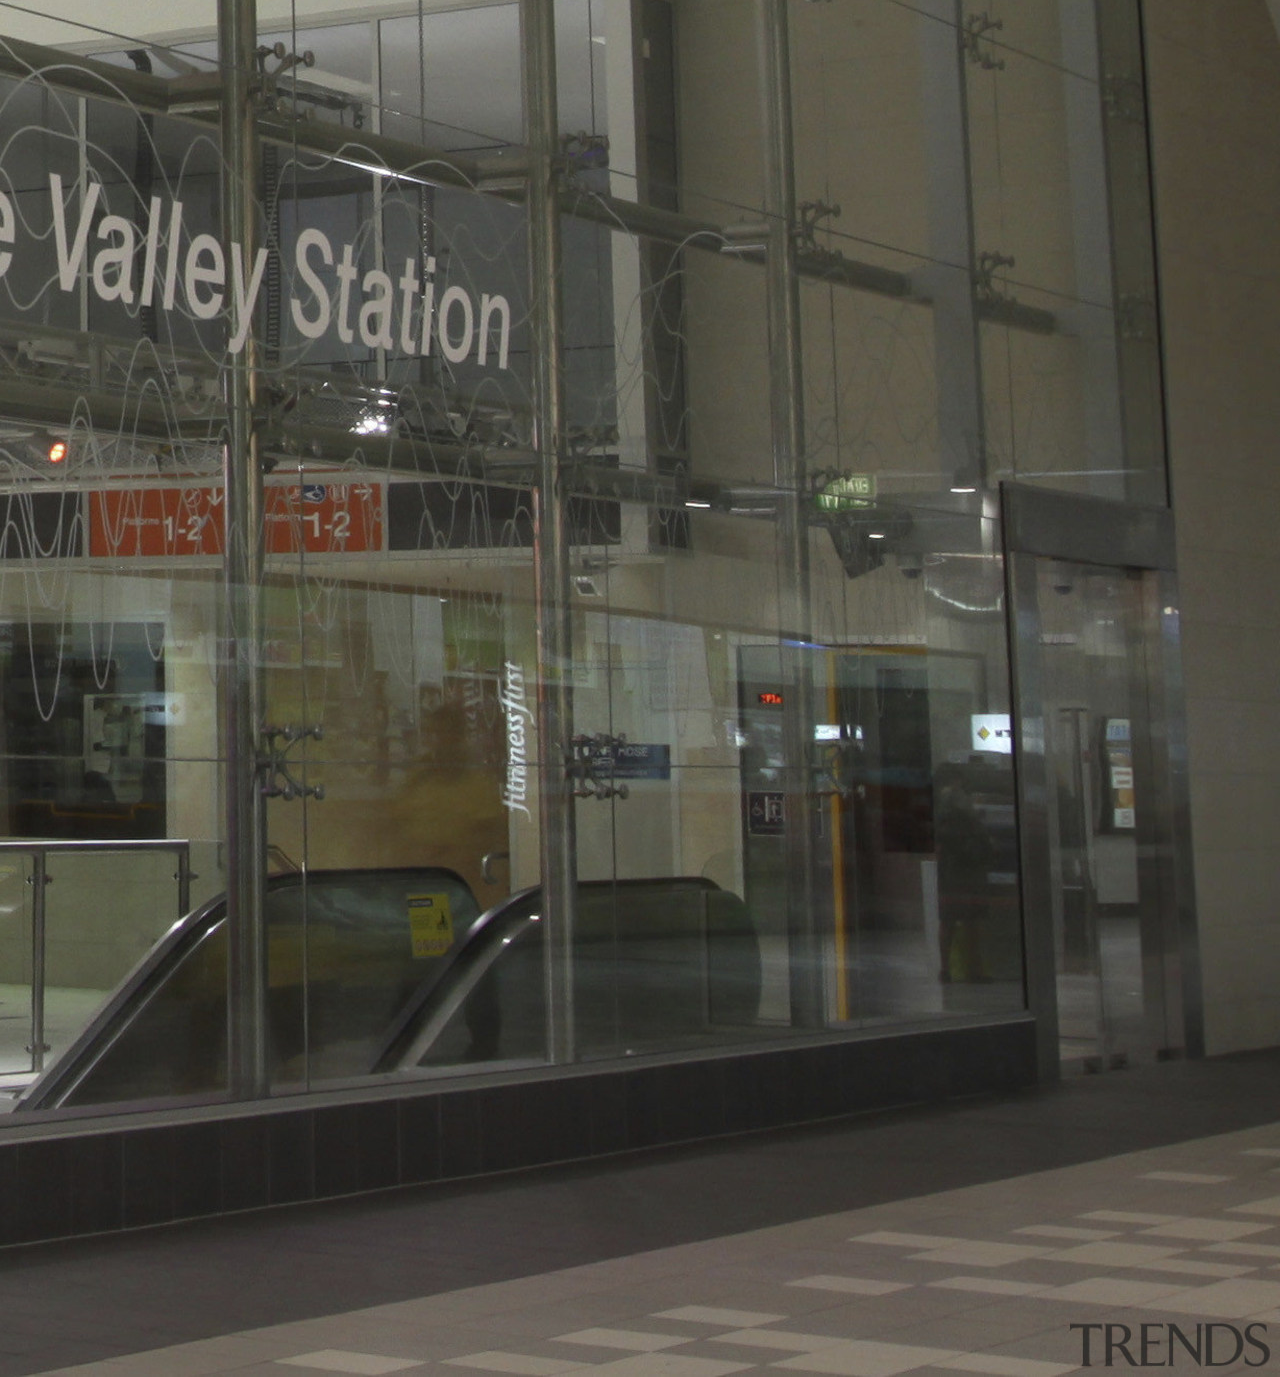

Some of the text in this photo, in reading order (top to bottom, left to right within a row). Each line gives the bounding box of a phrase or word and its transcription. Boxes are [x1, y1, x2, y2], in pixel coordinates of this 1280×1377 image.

[49, 173, 268, 354] Valley
[290, 227, 512, 370] Station
[164, 514, 204, 542] 1-2
[303, 511, 352, 539] 1-2
